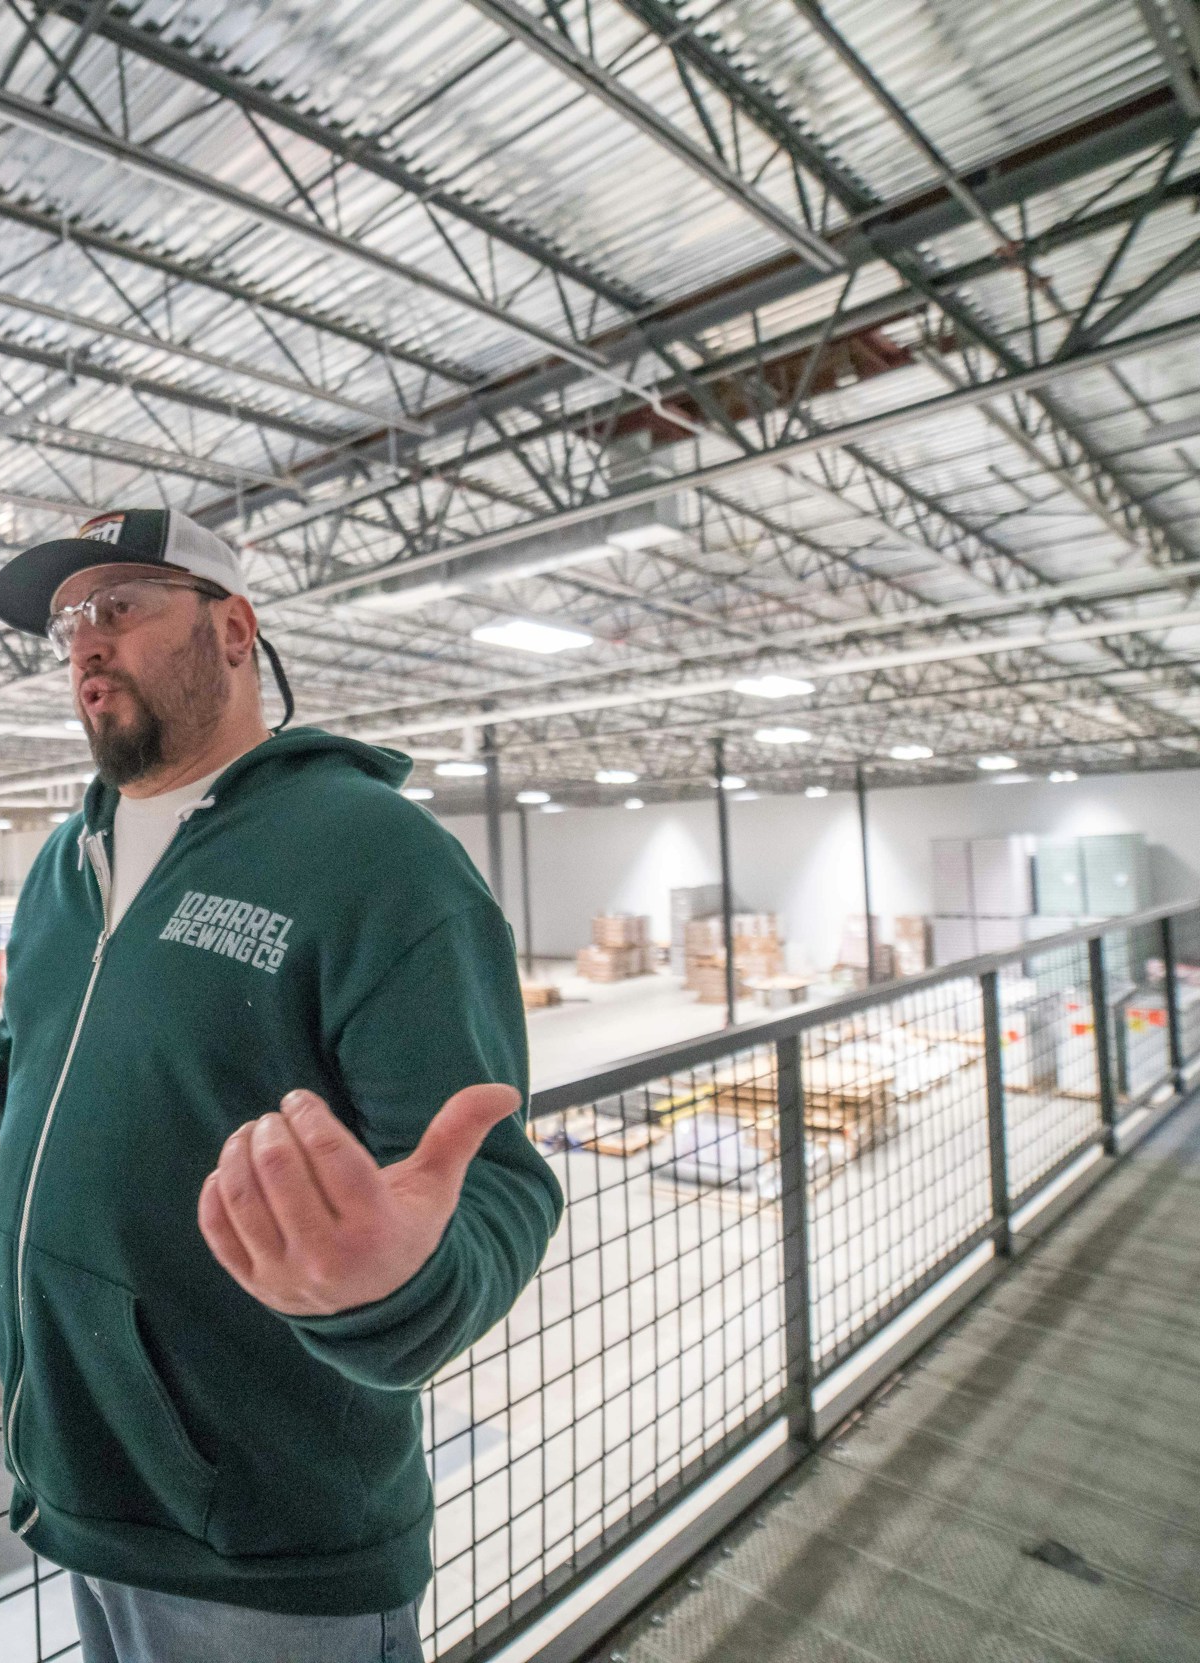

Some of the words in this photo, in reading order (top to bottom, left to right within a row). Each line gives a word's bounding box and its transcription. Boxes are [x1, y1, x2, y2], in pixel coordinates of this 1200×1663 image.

[159, 917, 256, 963] BREWING
[173, 890, 204, 919] 10
[195, 895, 294, 950] BARREL
